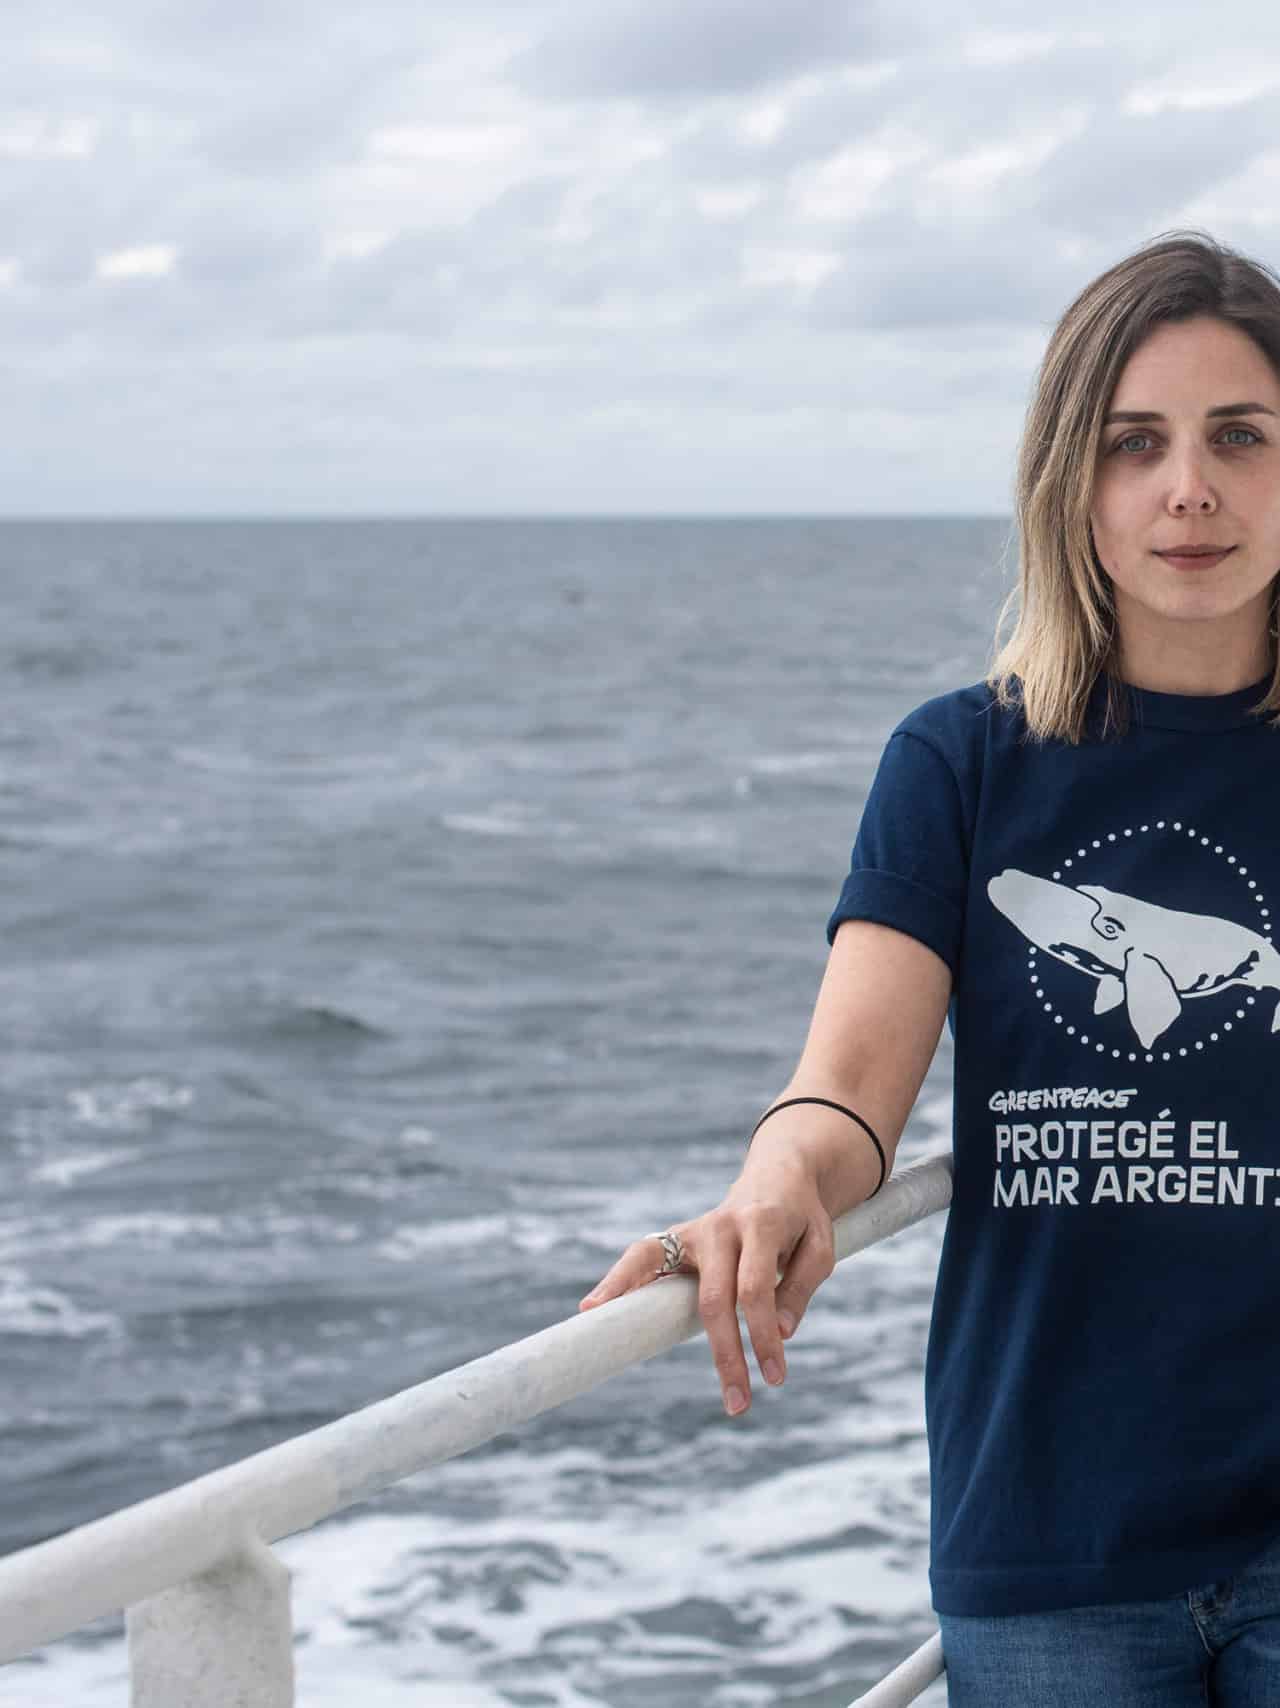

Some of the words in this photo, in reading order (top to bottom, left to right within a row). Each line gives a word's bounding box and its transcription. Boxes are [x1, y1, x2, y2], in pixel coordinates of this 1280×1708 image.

[988, 1087, 1138, 1114] GREENPEACE
[995, 1108, 1176, 1163] PROTEGÉ
[1189, 1120, 1240, 1160] EL
[993, 1165, 1080, 1208] MAR
